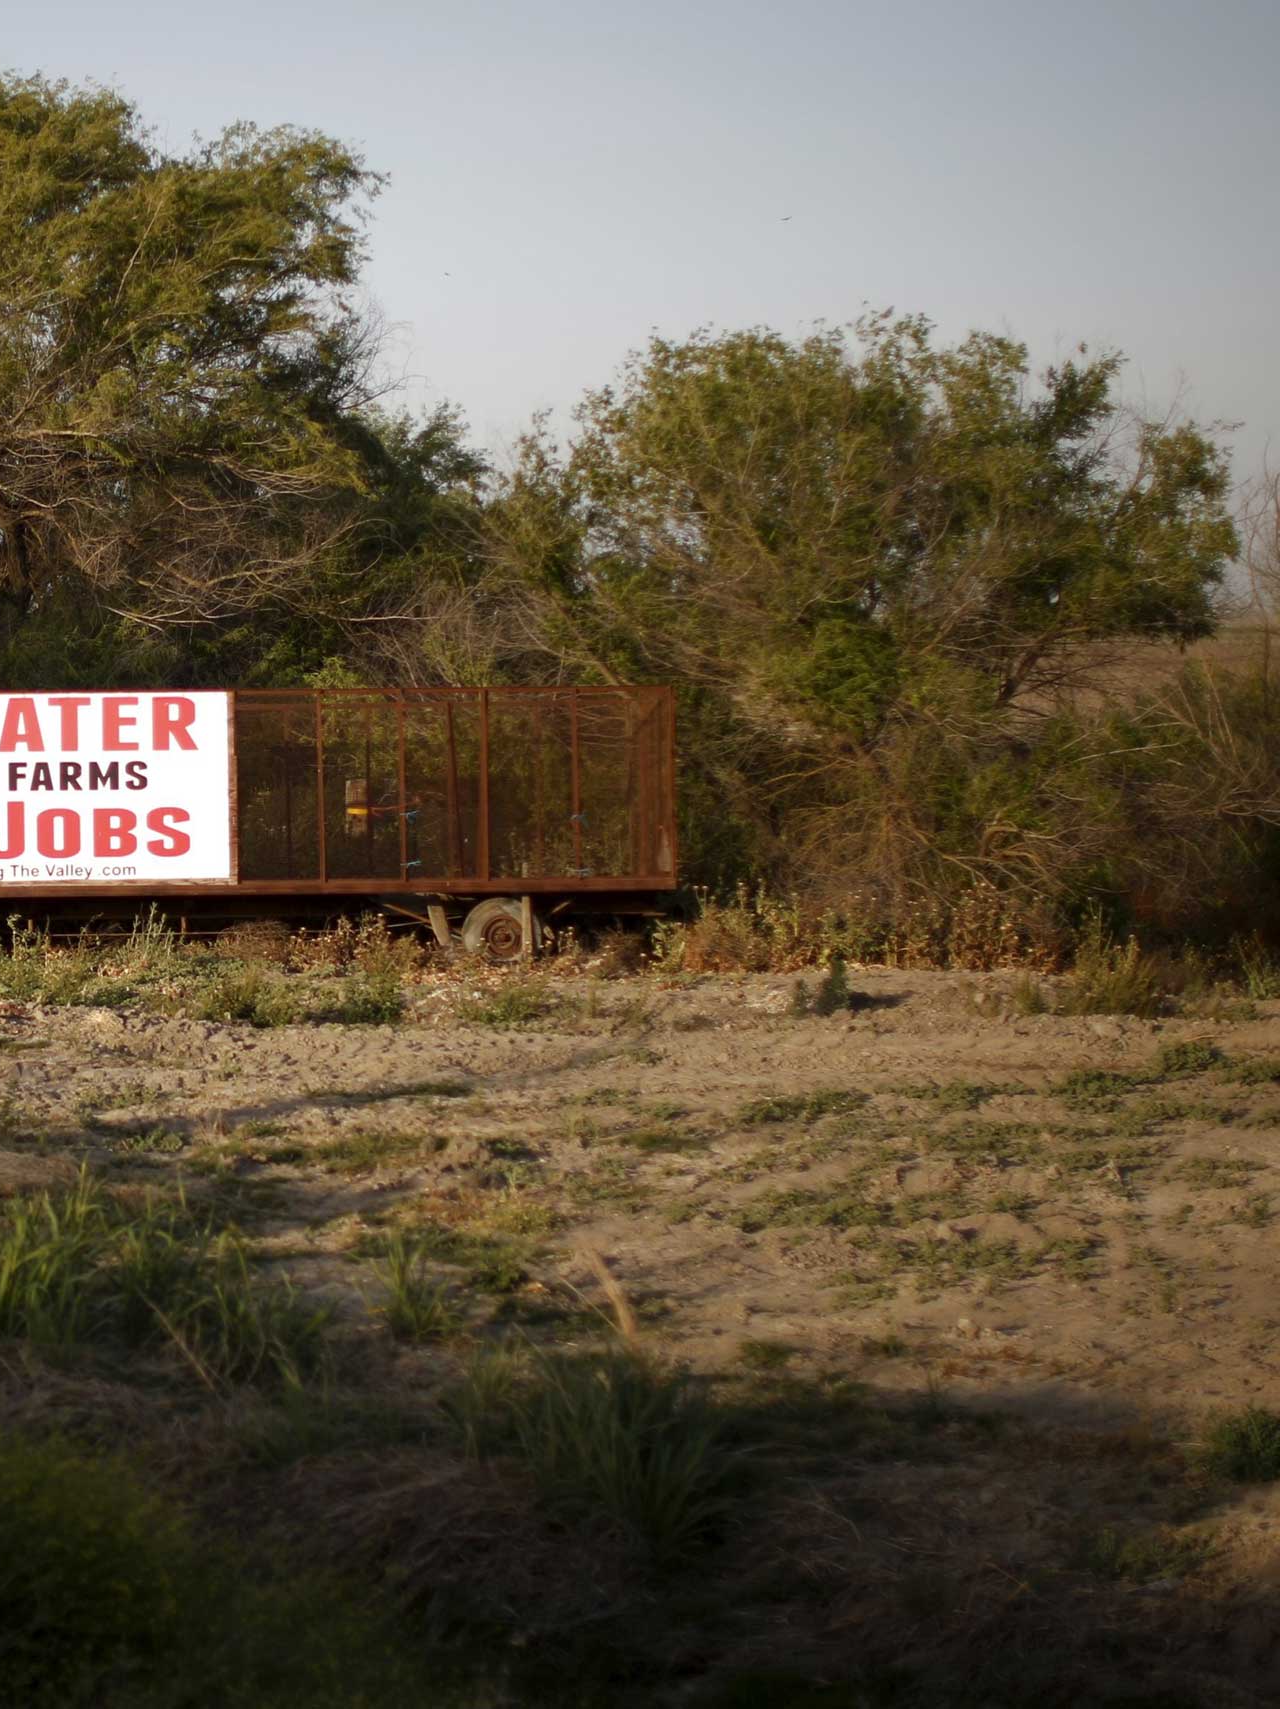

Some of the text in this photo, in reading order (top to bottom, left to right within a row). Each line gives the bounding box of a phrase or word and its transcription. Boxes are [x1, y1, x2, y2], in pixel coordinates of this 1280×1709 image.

[8, 761, 148, 792] FARMS
[10, 865, 40, 877] The
[46, 864, 94, 880] Valley
